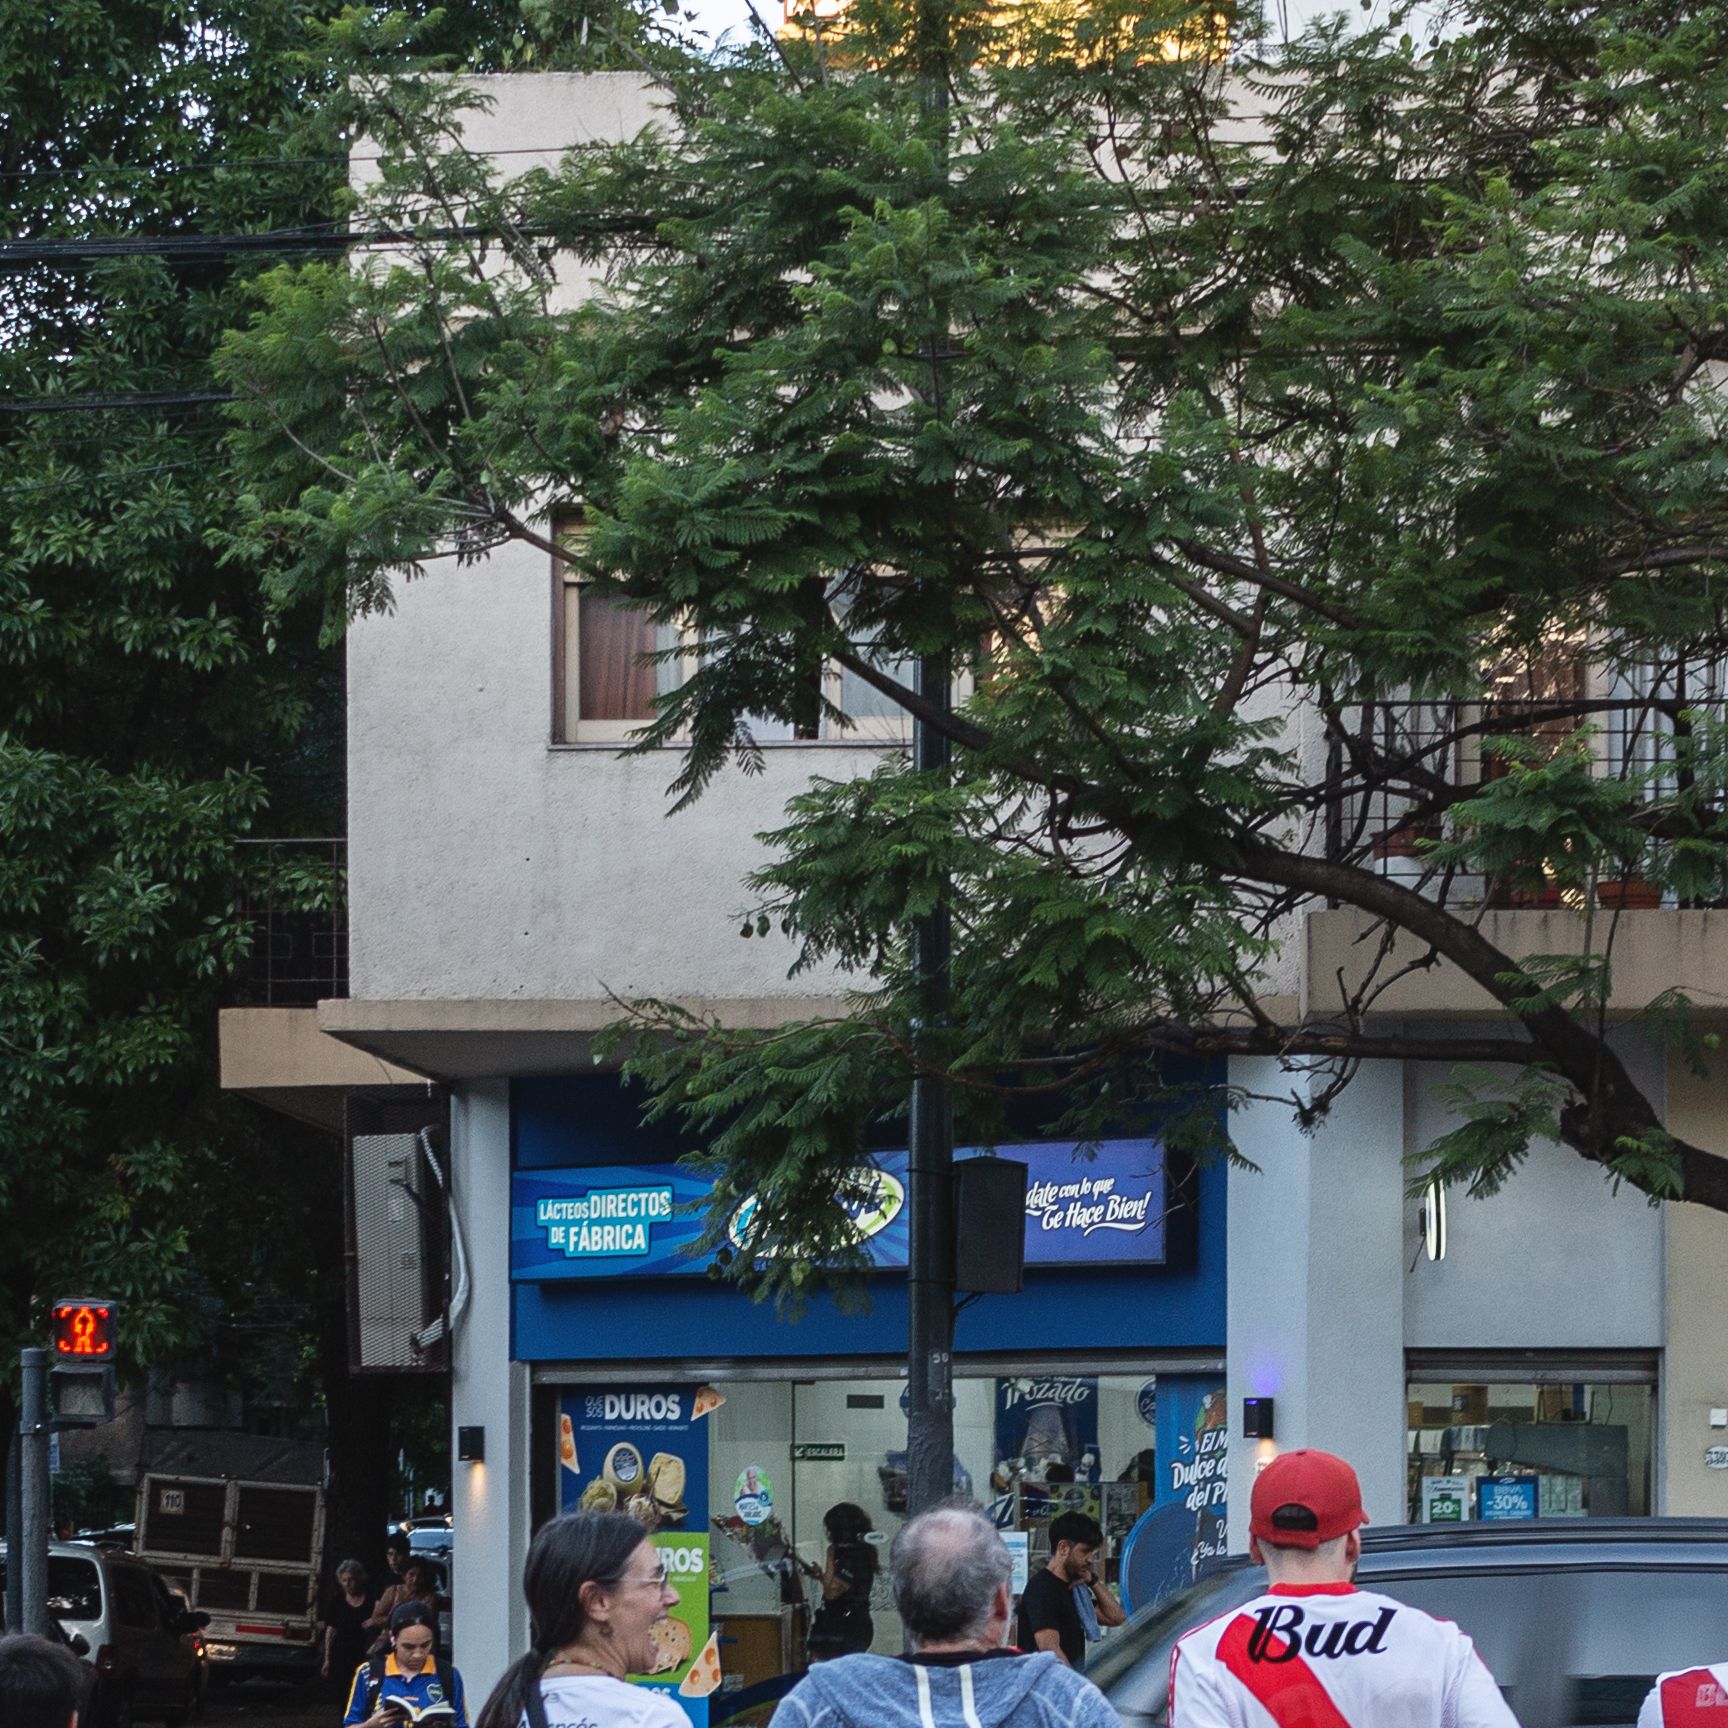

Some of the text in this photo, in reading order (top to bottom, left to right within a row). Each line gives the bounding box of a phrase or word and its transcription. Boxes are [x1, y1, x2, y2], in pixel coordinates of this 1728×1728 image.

[1092, 1177, 1115, 1201] que
[539, 1191, 672, 1221] LÁCTEOS DIRECTOS
[1064, 1202, 1103, 1230] Hace
[1105, 1191, 1153, 1222] Bien!
[551, 1220, 646, 1253] DE FÁBRICA
[604, 1393, 682, 1421] DUROS
[1171, 1454, 1216, 1490] Dulce
[1186, 1483, 1212, 1511] del
[656, 1547, 704, 1574] ROS
[1247, 1603, 1397, 1665] Bud
